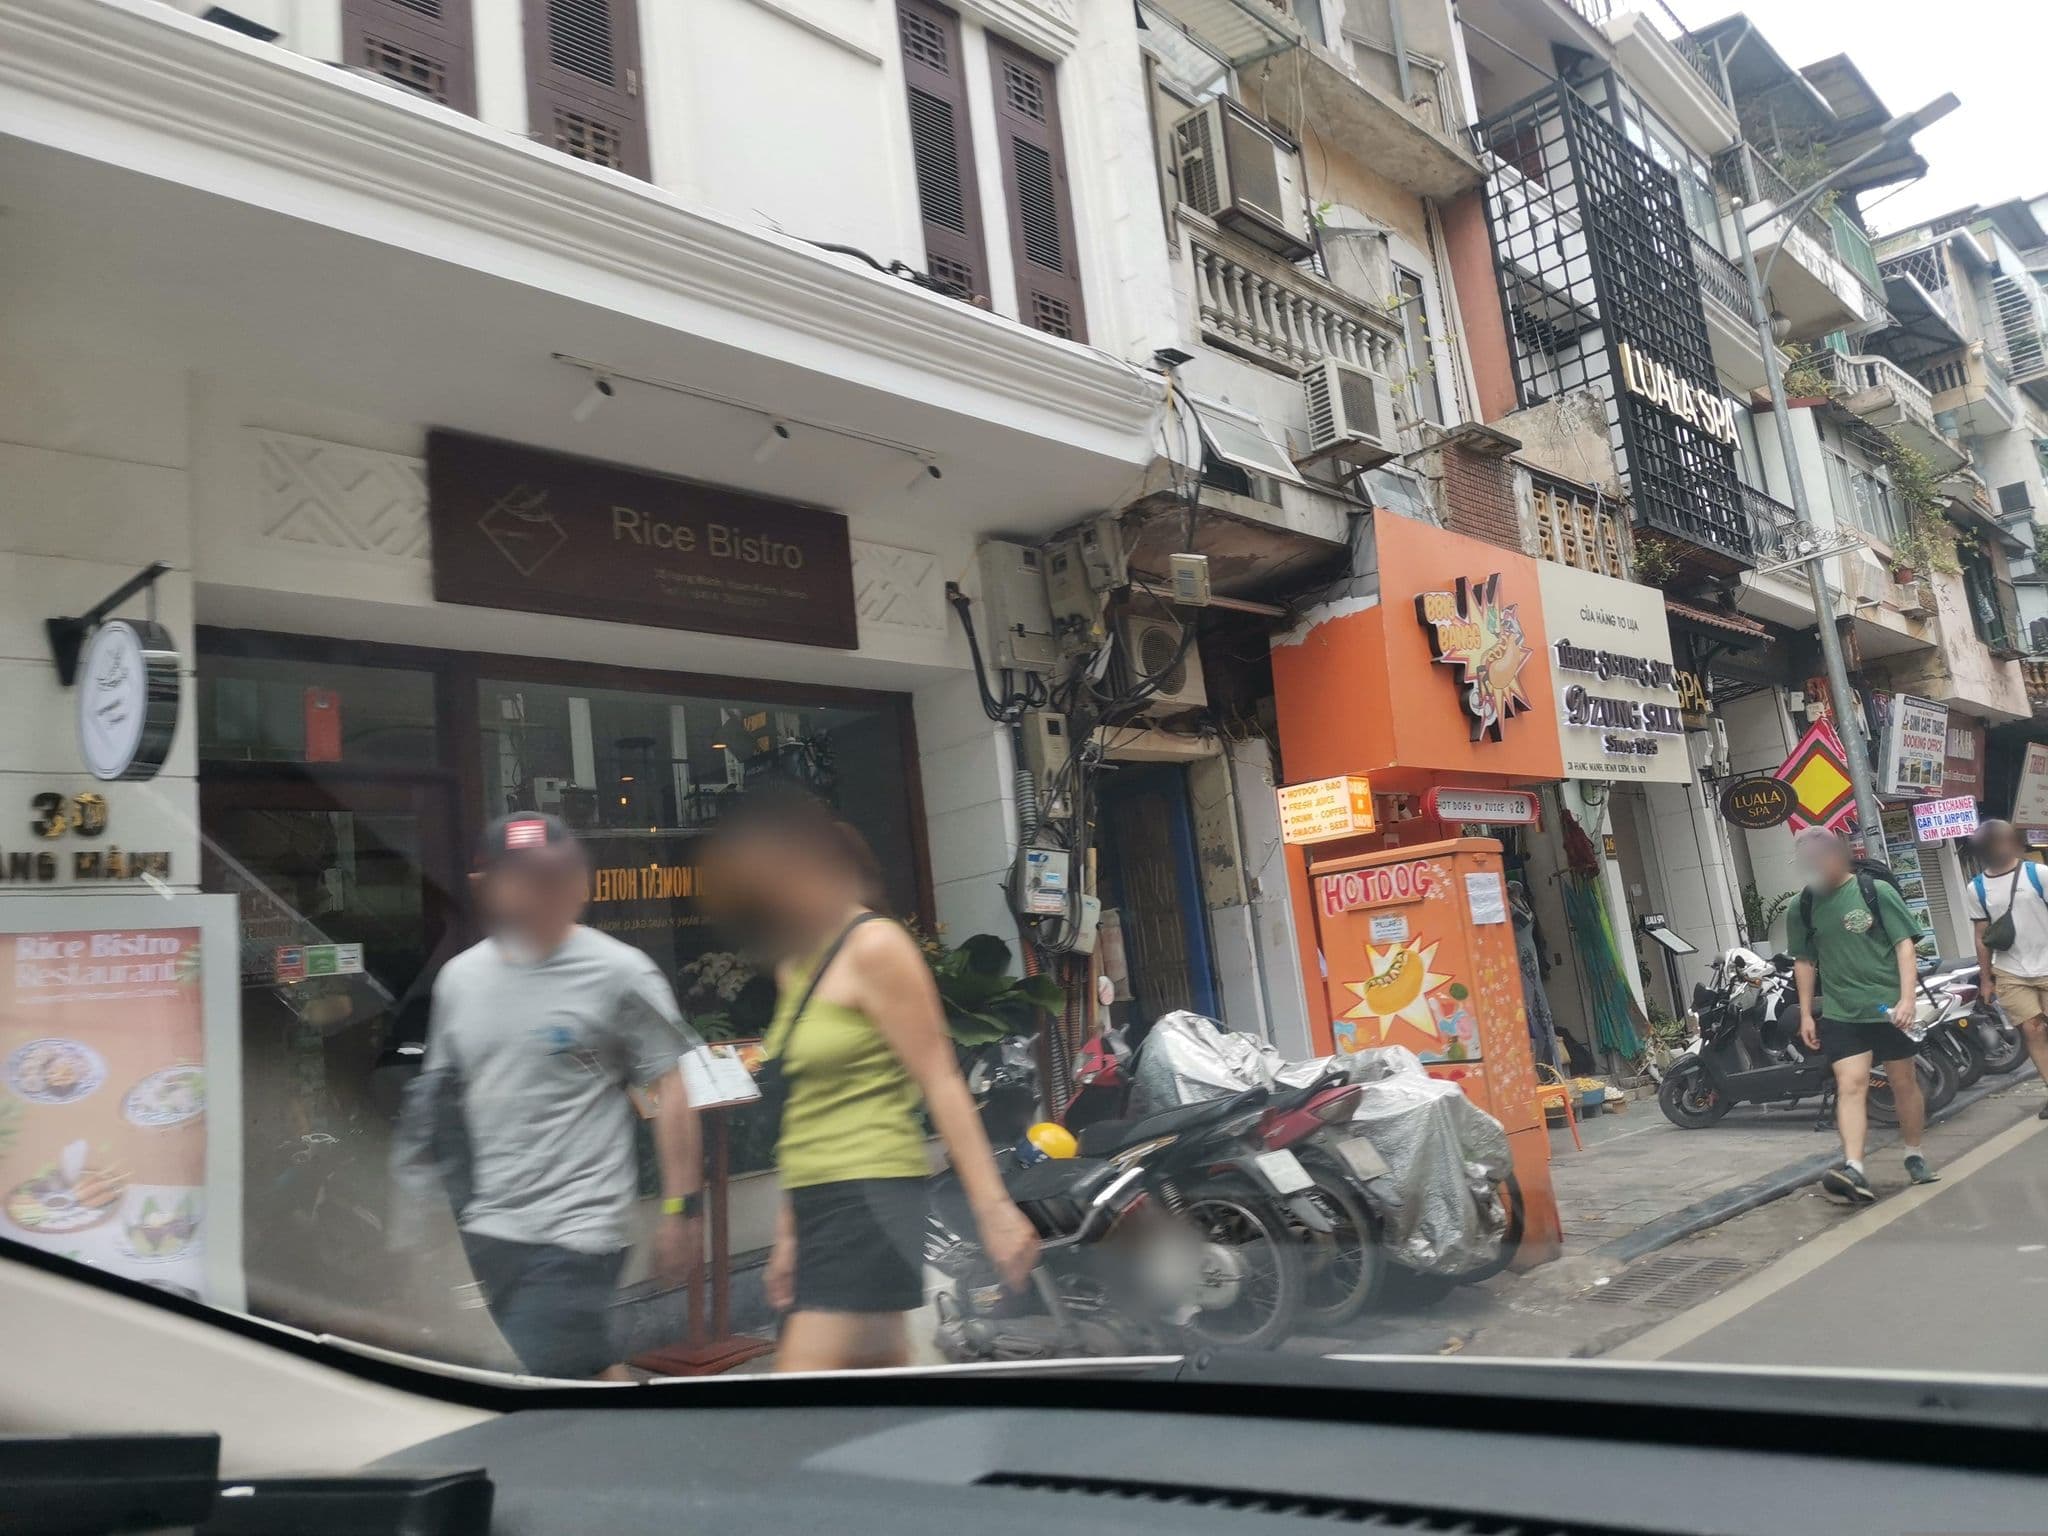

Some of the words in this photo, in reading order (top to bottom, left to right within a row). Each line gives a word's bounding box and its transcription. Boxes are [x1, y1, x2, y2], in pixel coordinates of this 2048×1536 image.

[1618, 342, 1701, 430] LUALA
[1697, 388, 1742, 449] SPA
[611, 504, 697, 553] Rice
[707, 522, 804, 570] Bistro
[1598, 650, 1650, 688] SISTERS
[1674, 670, 1709, 714] SPA
[1642, 702, 1684, 735] SILK
[1287, 786, 1319, 799] HOTDOG
[1734, 790, 1781, 809] LUALA
[32, 791, 108, 840] 30
[1320, 806, 1347, 818] COFFEE
[1453, 801, 1471, 811] DOGS
[1485, 802, 1505, 812] JUICE
[1515, 801, 1525, 814] 28
[1748, 805, 1770, 817] SPA
[1913, 803, 1937, 816] MONEY
[1938, 798, 1973, 812] EXCHANGE
[1329, 819, 1348, 831] BEER
[1918, 816, 1933, 828] CAR
[1933, 815, 1942, 826] TO
[1944, 811, 1974, 824] AIRPORT
[1923, 828, 1939, 839] SIM
[1940, 825, 1961, 837] CARD
[1962, 823, 1974, 833] 5G
[1322, 860, 1434, 916] HOTDOG
[89, 933, 182, 957] Bistro
